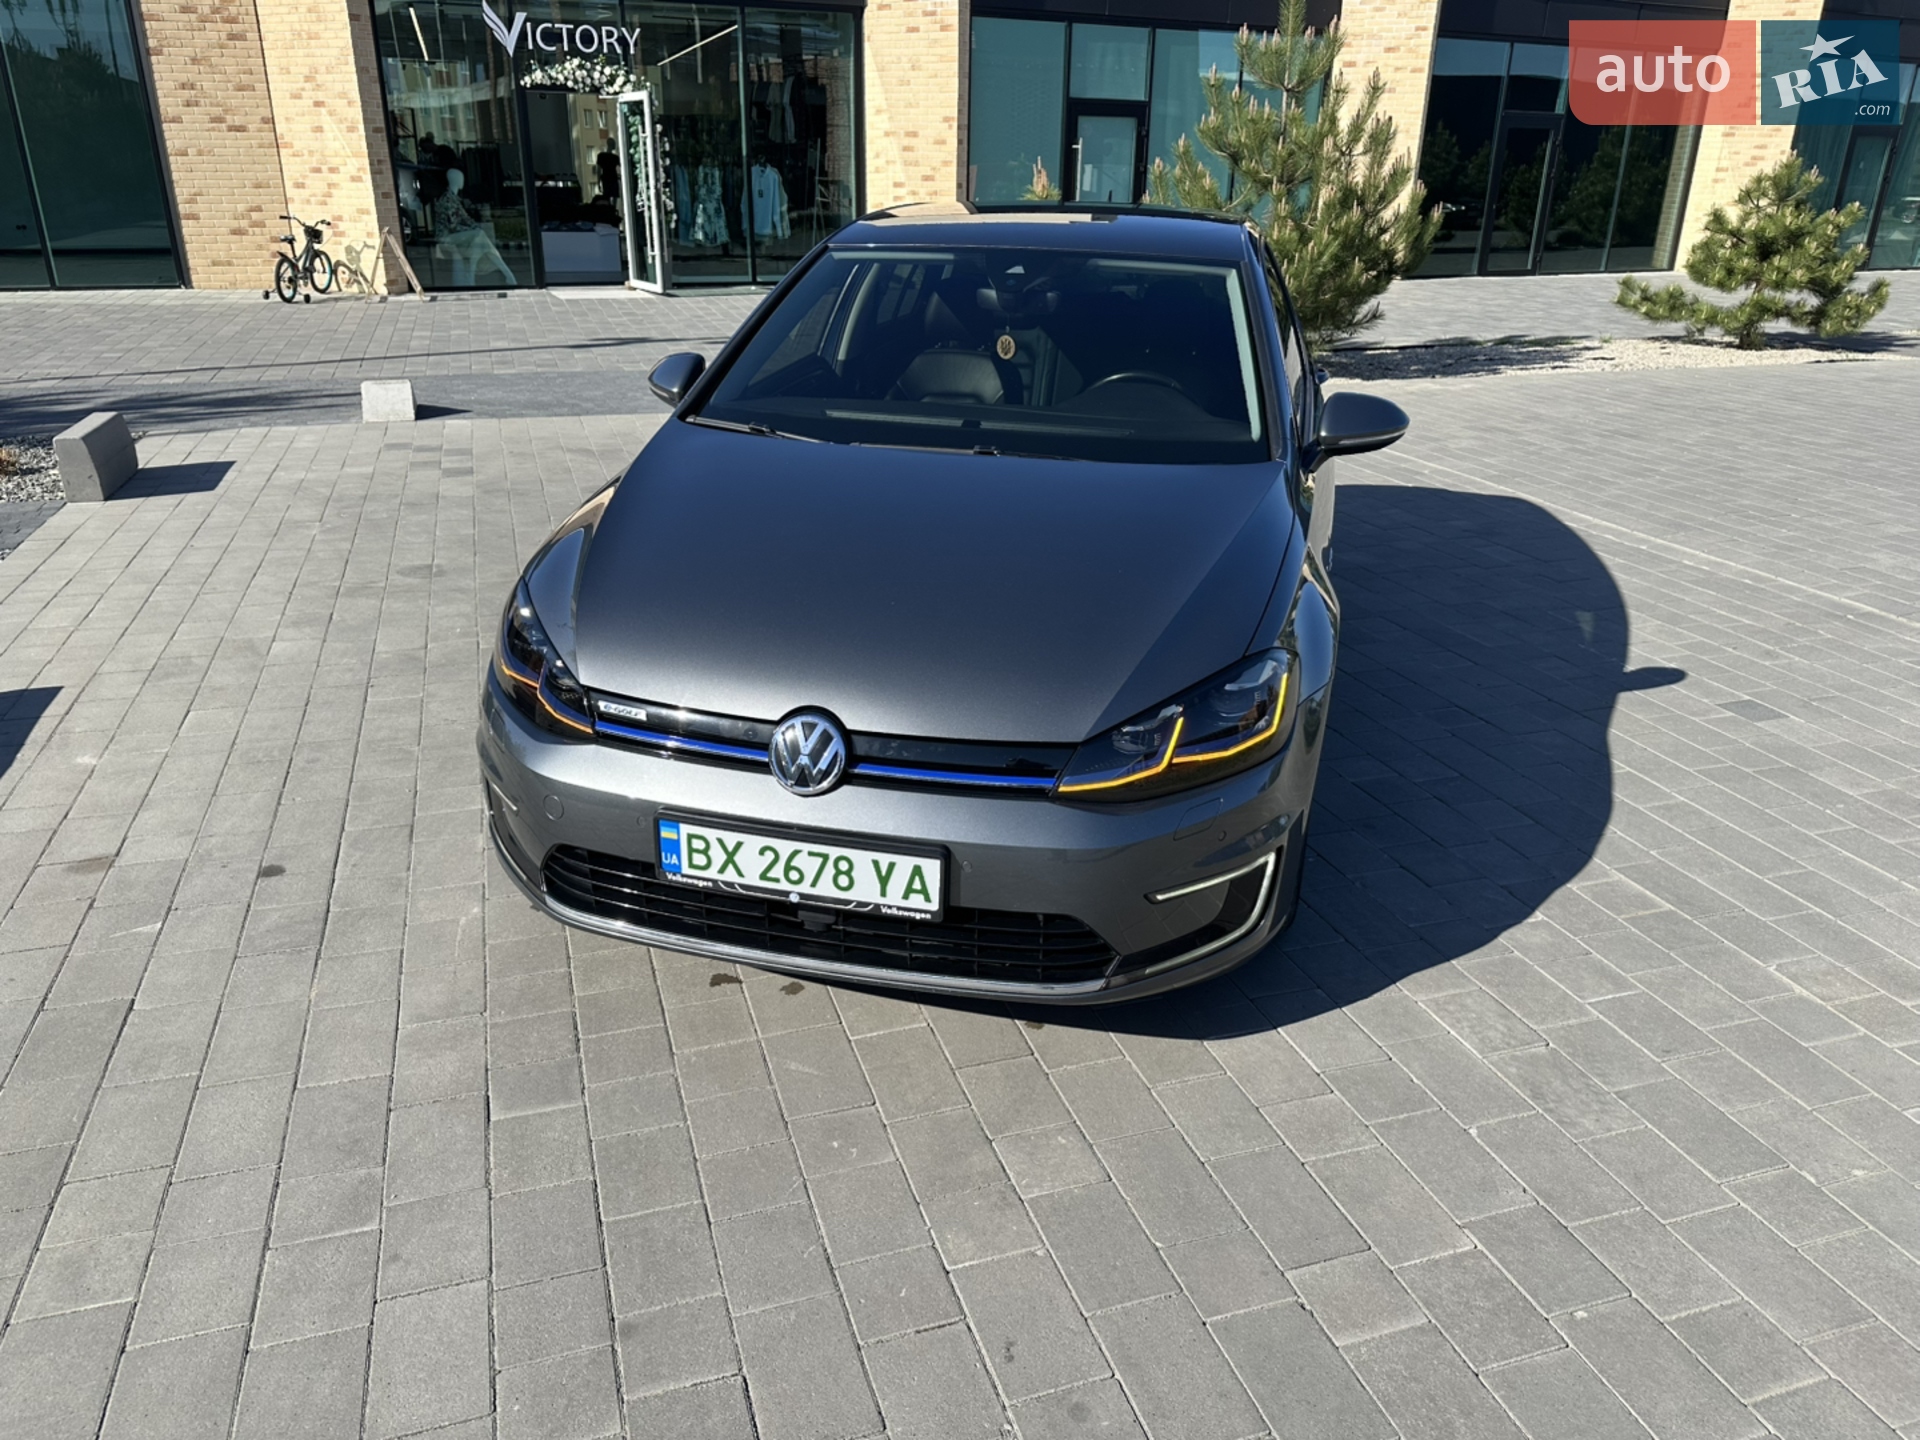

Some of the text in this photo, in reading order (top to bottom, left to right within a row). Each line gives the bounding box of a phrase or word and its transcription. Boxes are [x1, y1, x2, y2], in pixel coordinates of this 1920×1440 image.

[482, 0, 641, 57] VICTORY
[661, 851, 679, 866] UA
[686, 832, 932, 903] BX 2678 YA
[880, 904, 932, 920] Volkswagen
